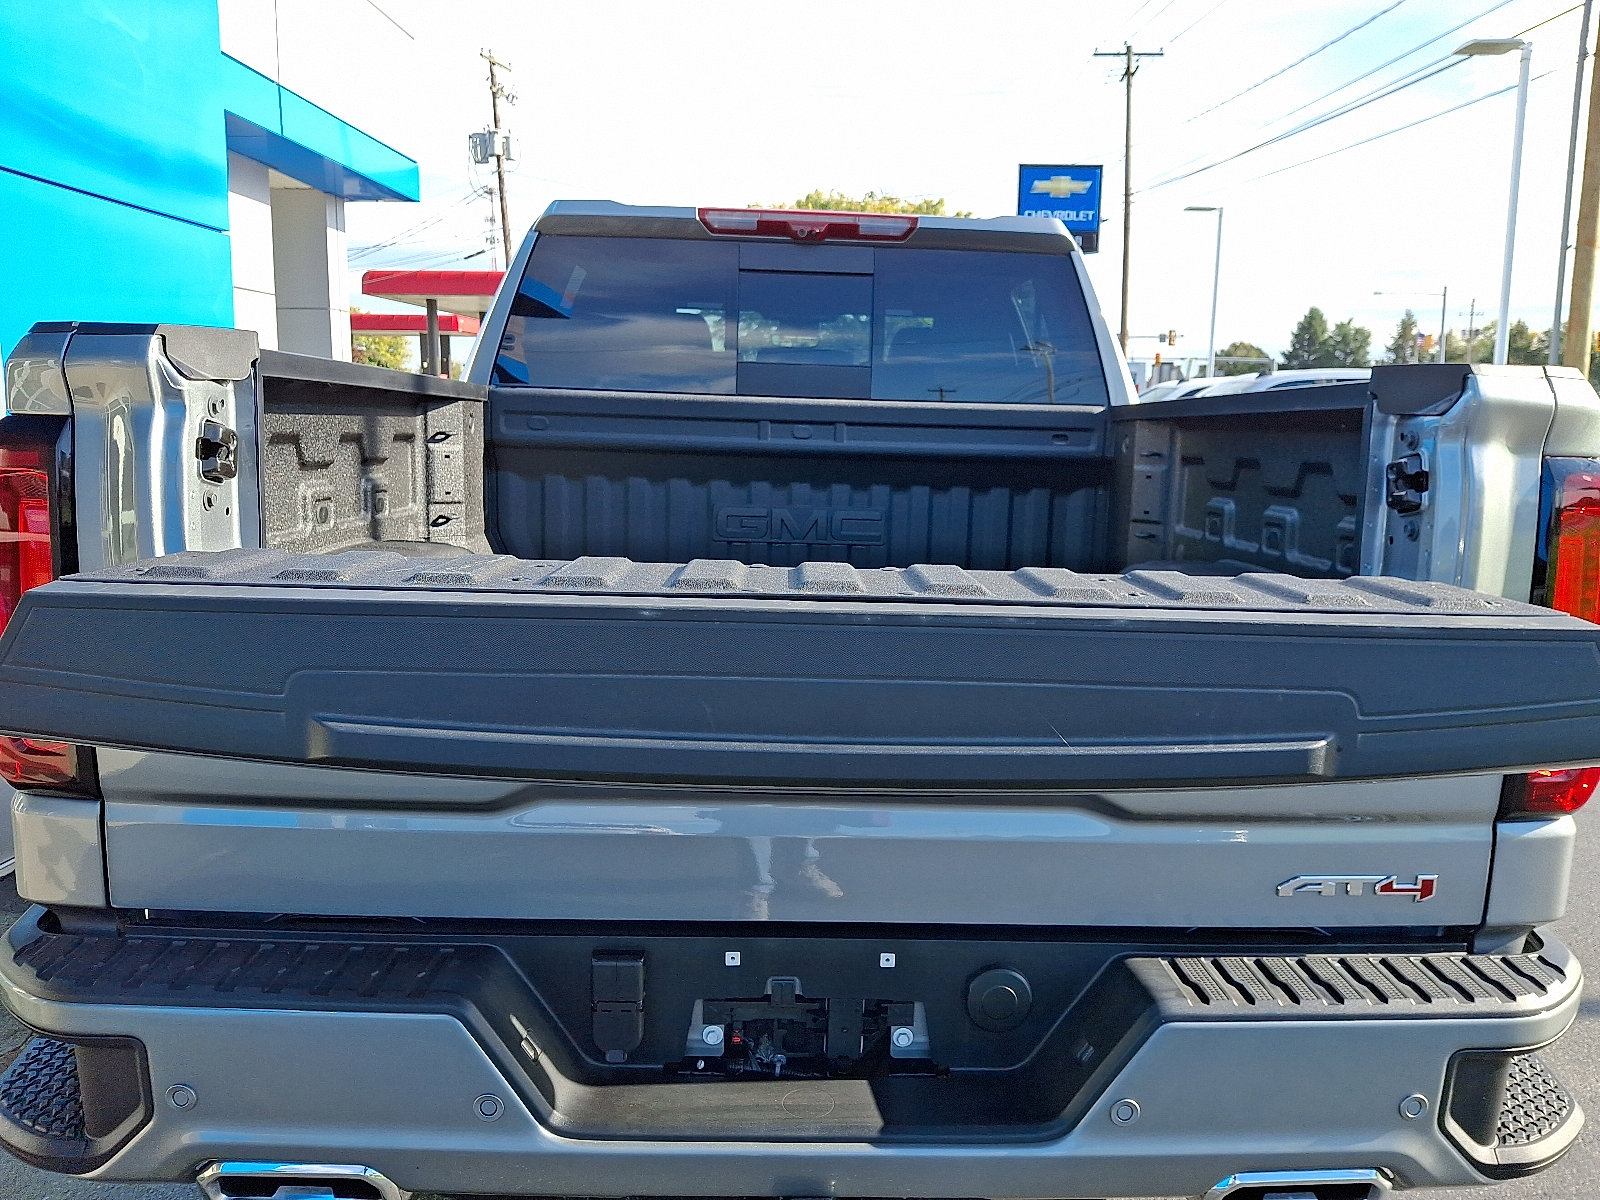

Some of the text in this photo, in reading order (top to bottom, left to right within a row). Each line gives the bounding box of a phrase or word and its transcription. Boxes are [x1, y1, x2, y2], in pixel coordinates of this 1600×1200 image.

[1024, 210, 1095, 221] CHEVROLET
[716, 506, 883, 542] GMC
[1276, 874, 1439, 902] AT4
